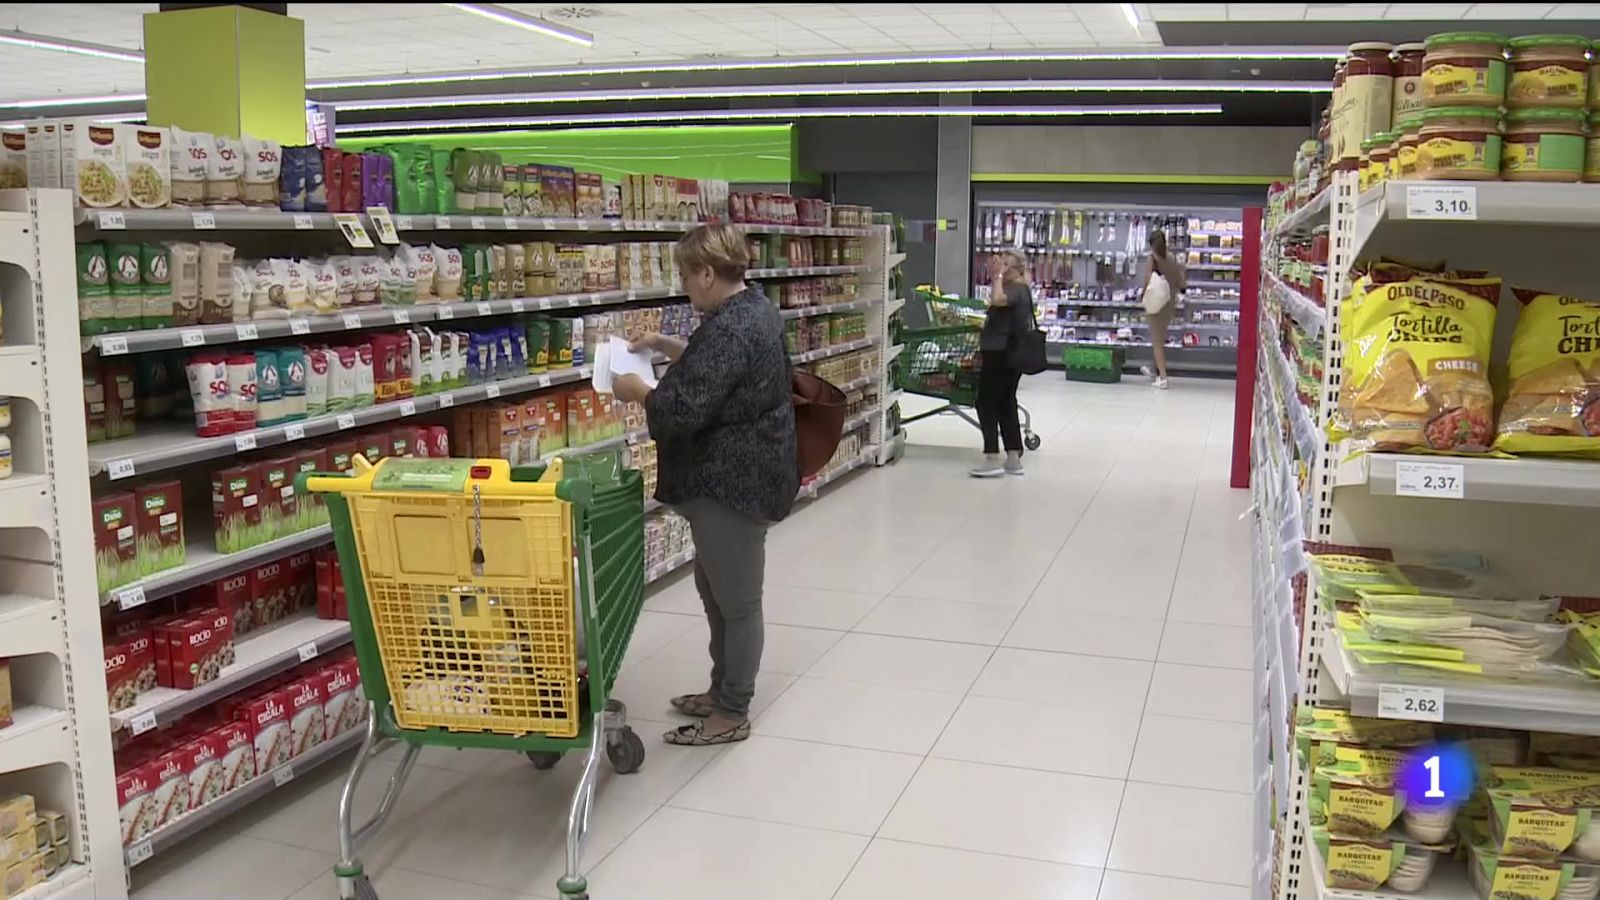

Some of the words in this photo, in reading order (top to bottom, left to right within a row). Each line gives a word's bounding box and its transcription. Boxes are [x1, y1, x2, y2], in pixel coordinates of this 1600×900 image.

[258, 151, 279, 163] SOS
[1435, 200, 1468, 214] 3,10
[1389, 311, 1463, 336] Tortilla
[1435, 360, 1478, 374] CHEESE
[240, 382, 257, 397] SO
[270, 471, 285, 482] Dino
[1423, 475, 1456, 490] 2,37
[230, 481, 247, 491] Dino
[146, 498, 164, 509] Dino
[103, 511, 122, 523] Dino
[104, 653, 126, 670] OCIO
[266, 699, 275, 710] LA
[1404, 698, 1437, 713] 2,62
[257, 704, 285, 725] CIGALA
[1339, 795, 1384, 807] BARQUITAS
[1518, 818, 1565, 828] BARQUITAS
[1337, 852, 1382, 862] BARQUITAS
[1504, 873, 1550, 882] BARQUITAS
